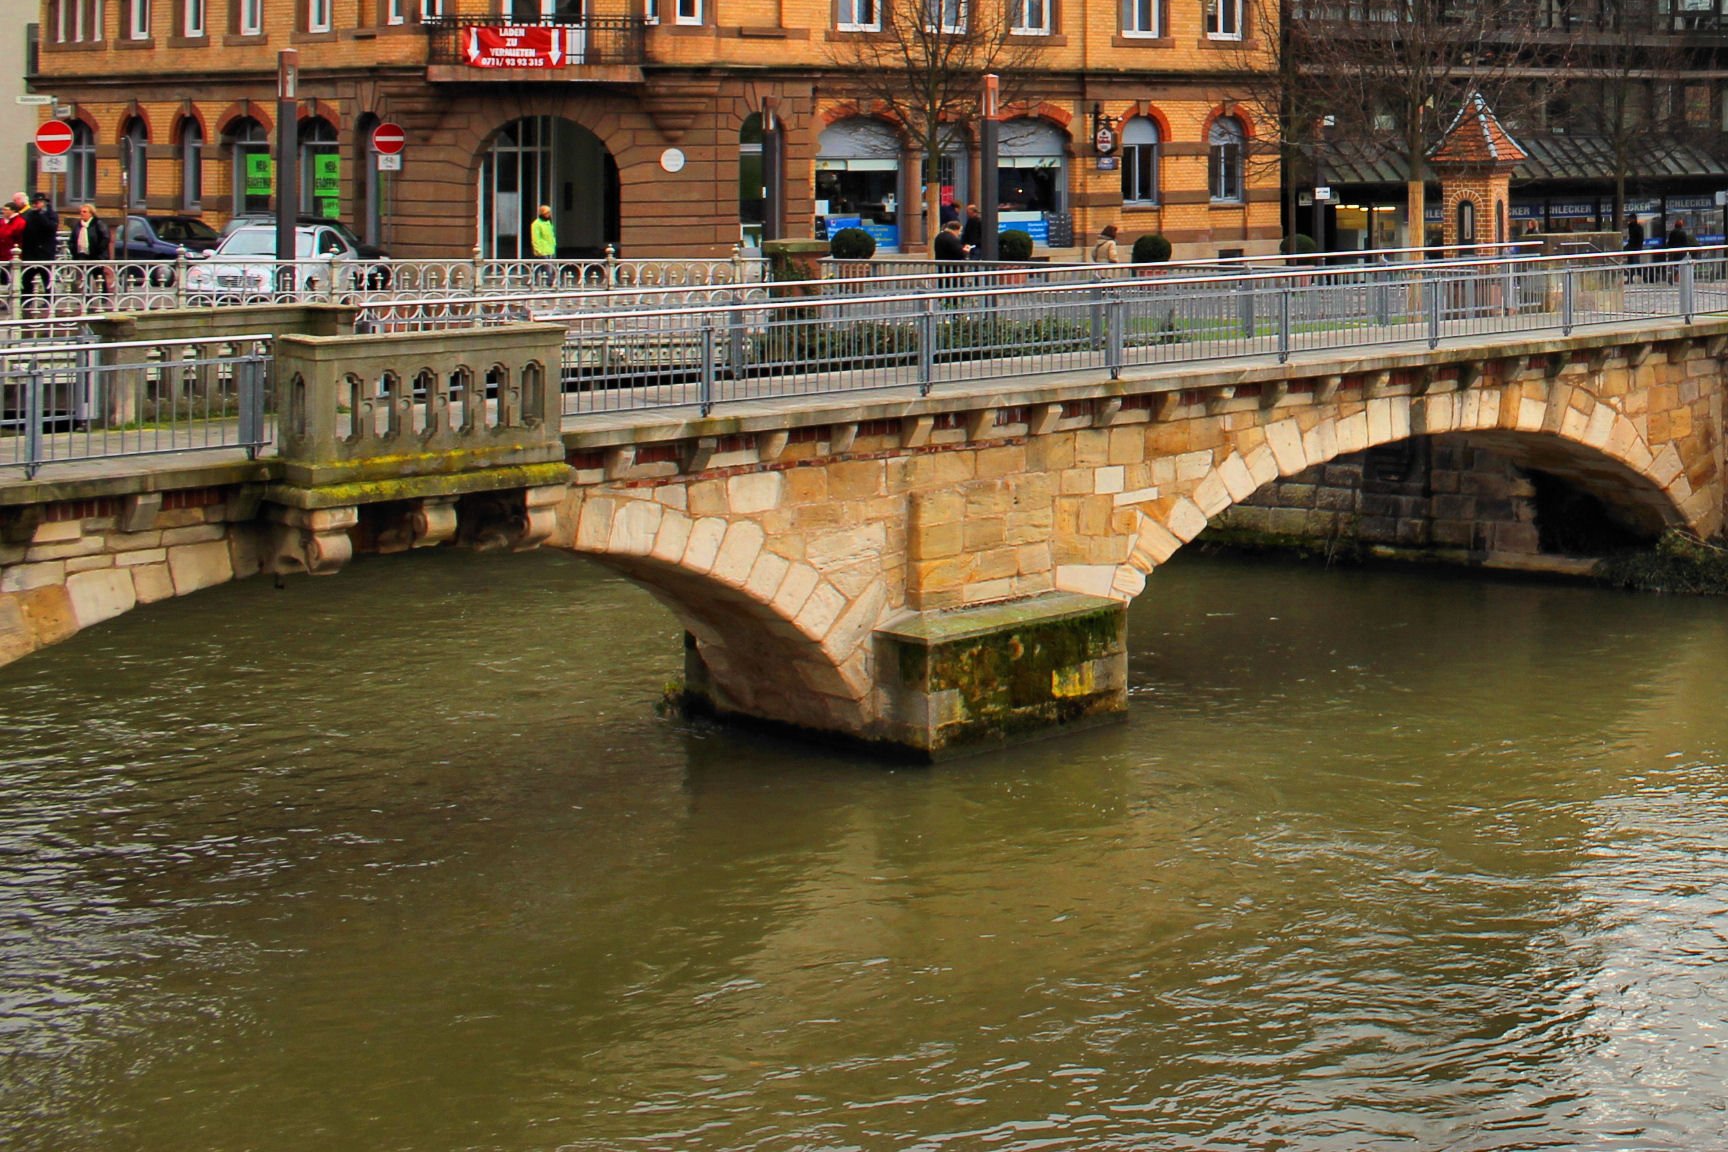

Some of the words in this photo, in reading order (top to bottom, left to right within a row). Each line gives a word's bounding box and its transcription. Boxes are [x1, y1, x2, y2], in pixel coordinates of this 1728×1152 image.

[499, 28, 525, 37] LADEN
[506, 38, 518, 47] ZU
[490, 48, 536, 57] VERMIETEN
[481, 57, 504, 66] 0711/
[505, 57, 516, 66] 93
[516, 58, 528, 66] 93
[528, 58, 544, 67] 315
[1539, 203, 1592, 215] SHLECKER
[1600, 202, 1650, 213] SCECKER
